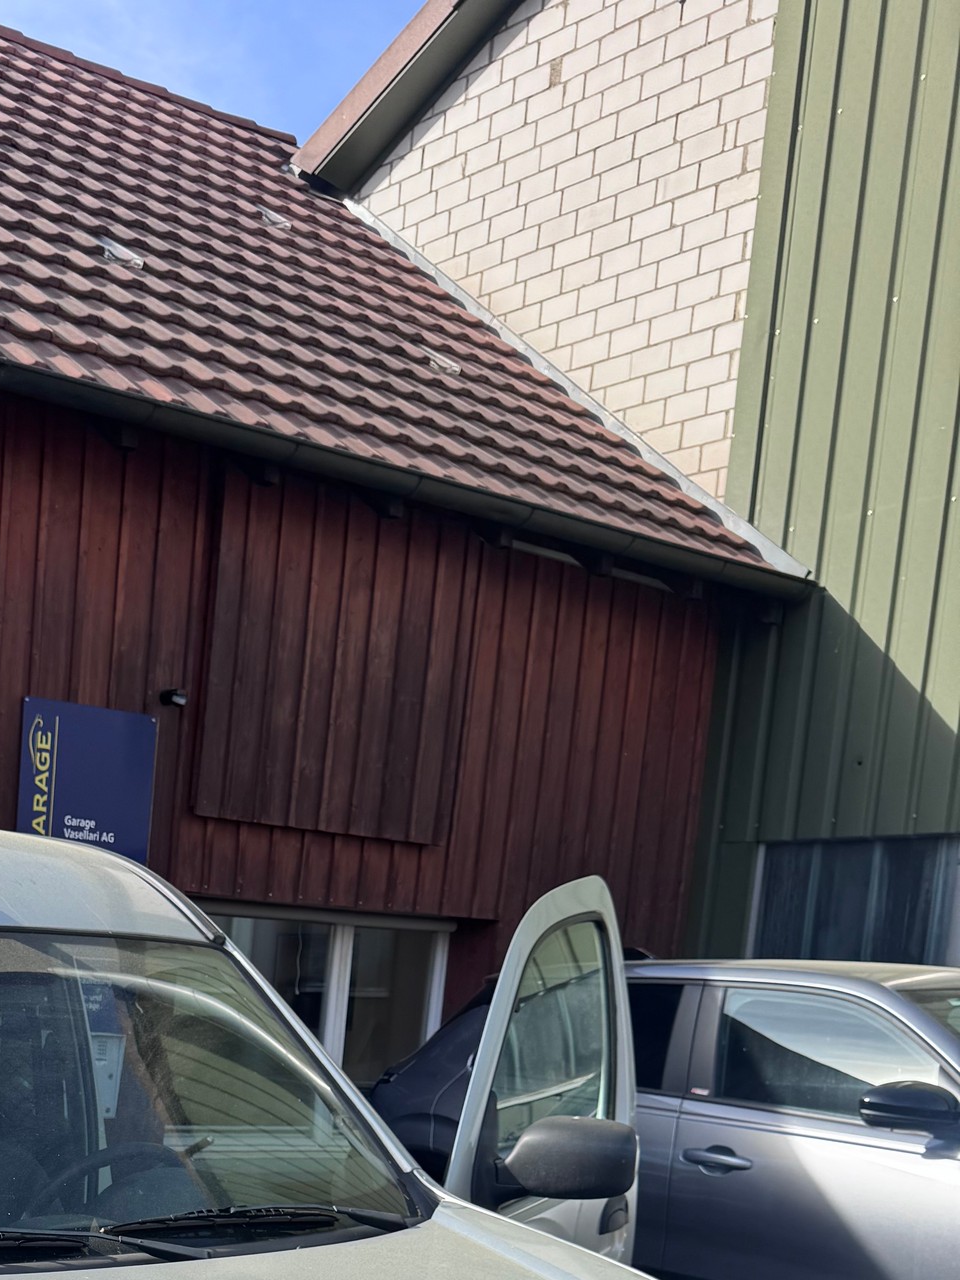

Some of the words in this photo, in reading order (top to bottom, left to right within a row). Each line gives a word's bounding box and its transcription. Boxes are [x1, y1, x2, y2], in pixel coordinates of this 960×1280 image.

[31, 731, 52, 836] ARAGE
[64, 815, 96, 830] Garage
[63, 828, 100, 842] Vasellari
[101, 832, 115, 844] AG
